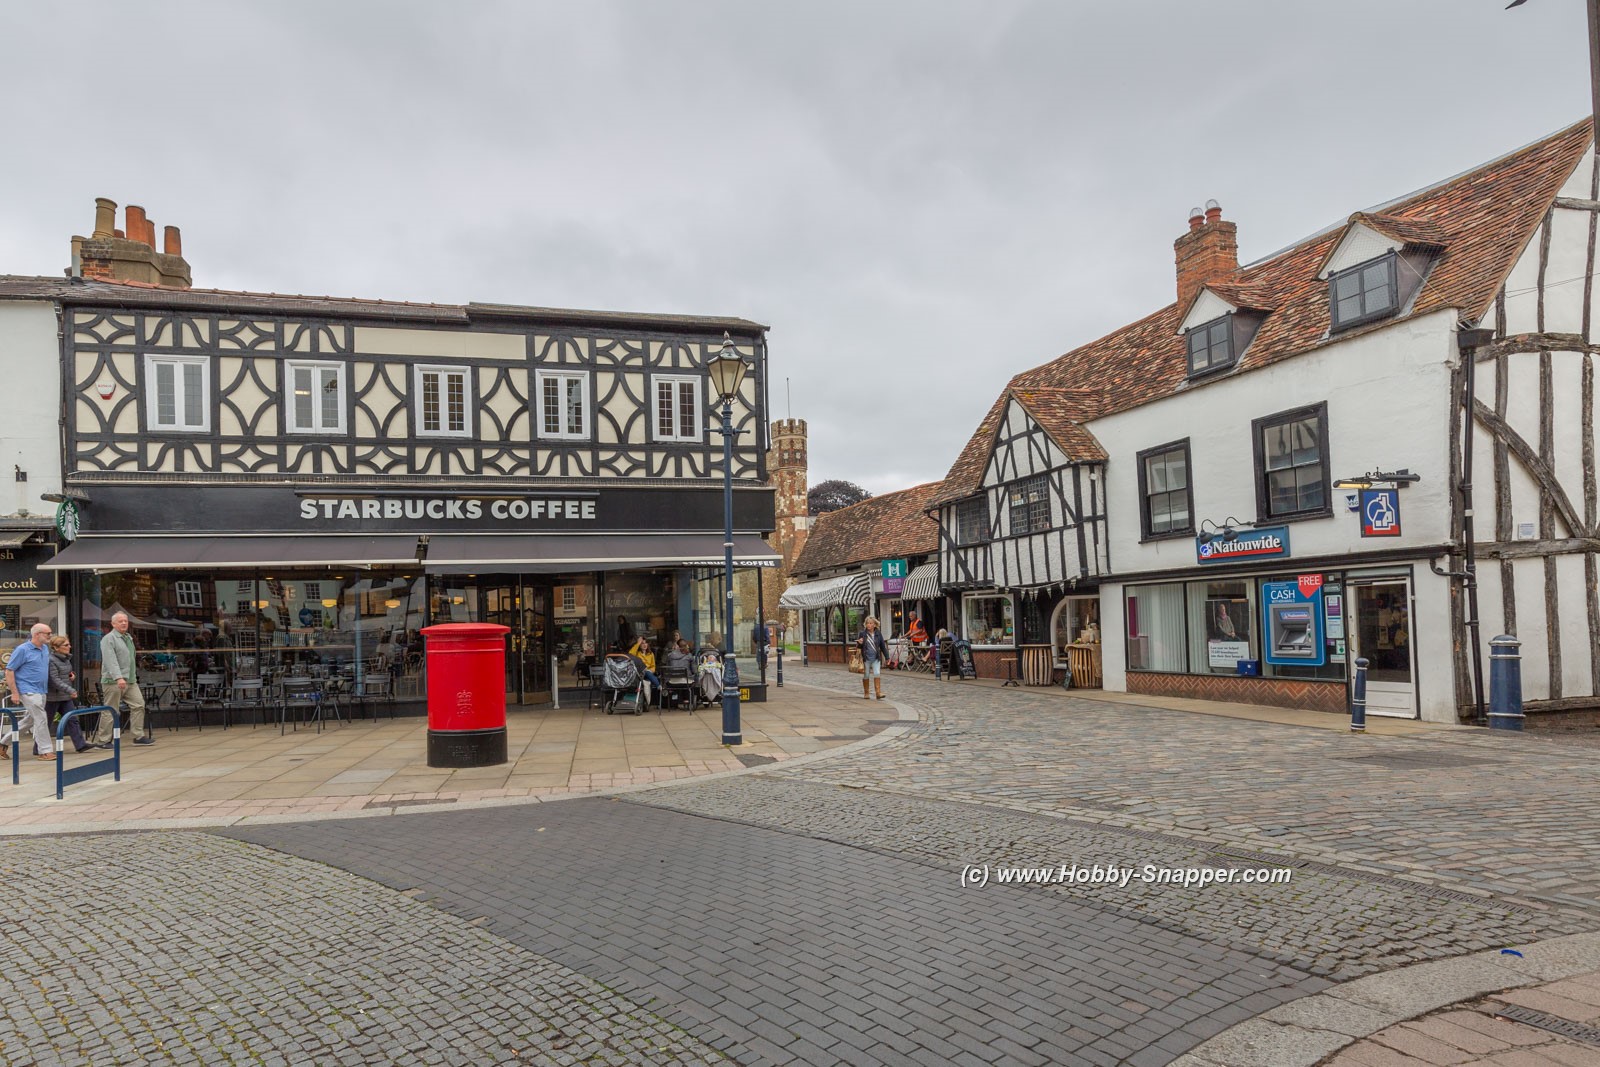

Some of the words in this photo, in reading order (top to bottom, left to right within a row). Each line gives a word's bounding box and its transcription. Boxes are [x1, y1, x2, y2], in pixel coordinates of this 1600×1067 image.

[300, 499, 483, 519] STARBUCKS
[490, 499, 597, 520] COFFEE
[1212, 535, 1282, 554] Nationwide
[740, 560, 776, 568] COFFEE
[0, 577, 38, 589] .co.uk
[1298, 575, 1321, 586] FREE
[1270, 589, 1295, 600] CASH
